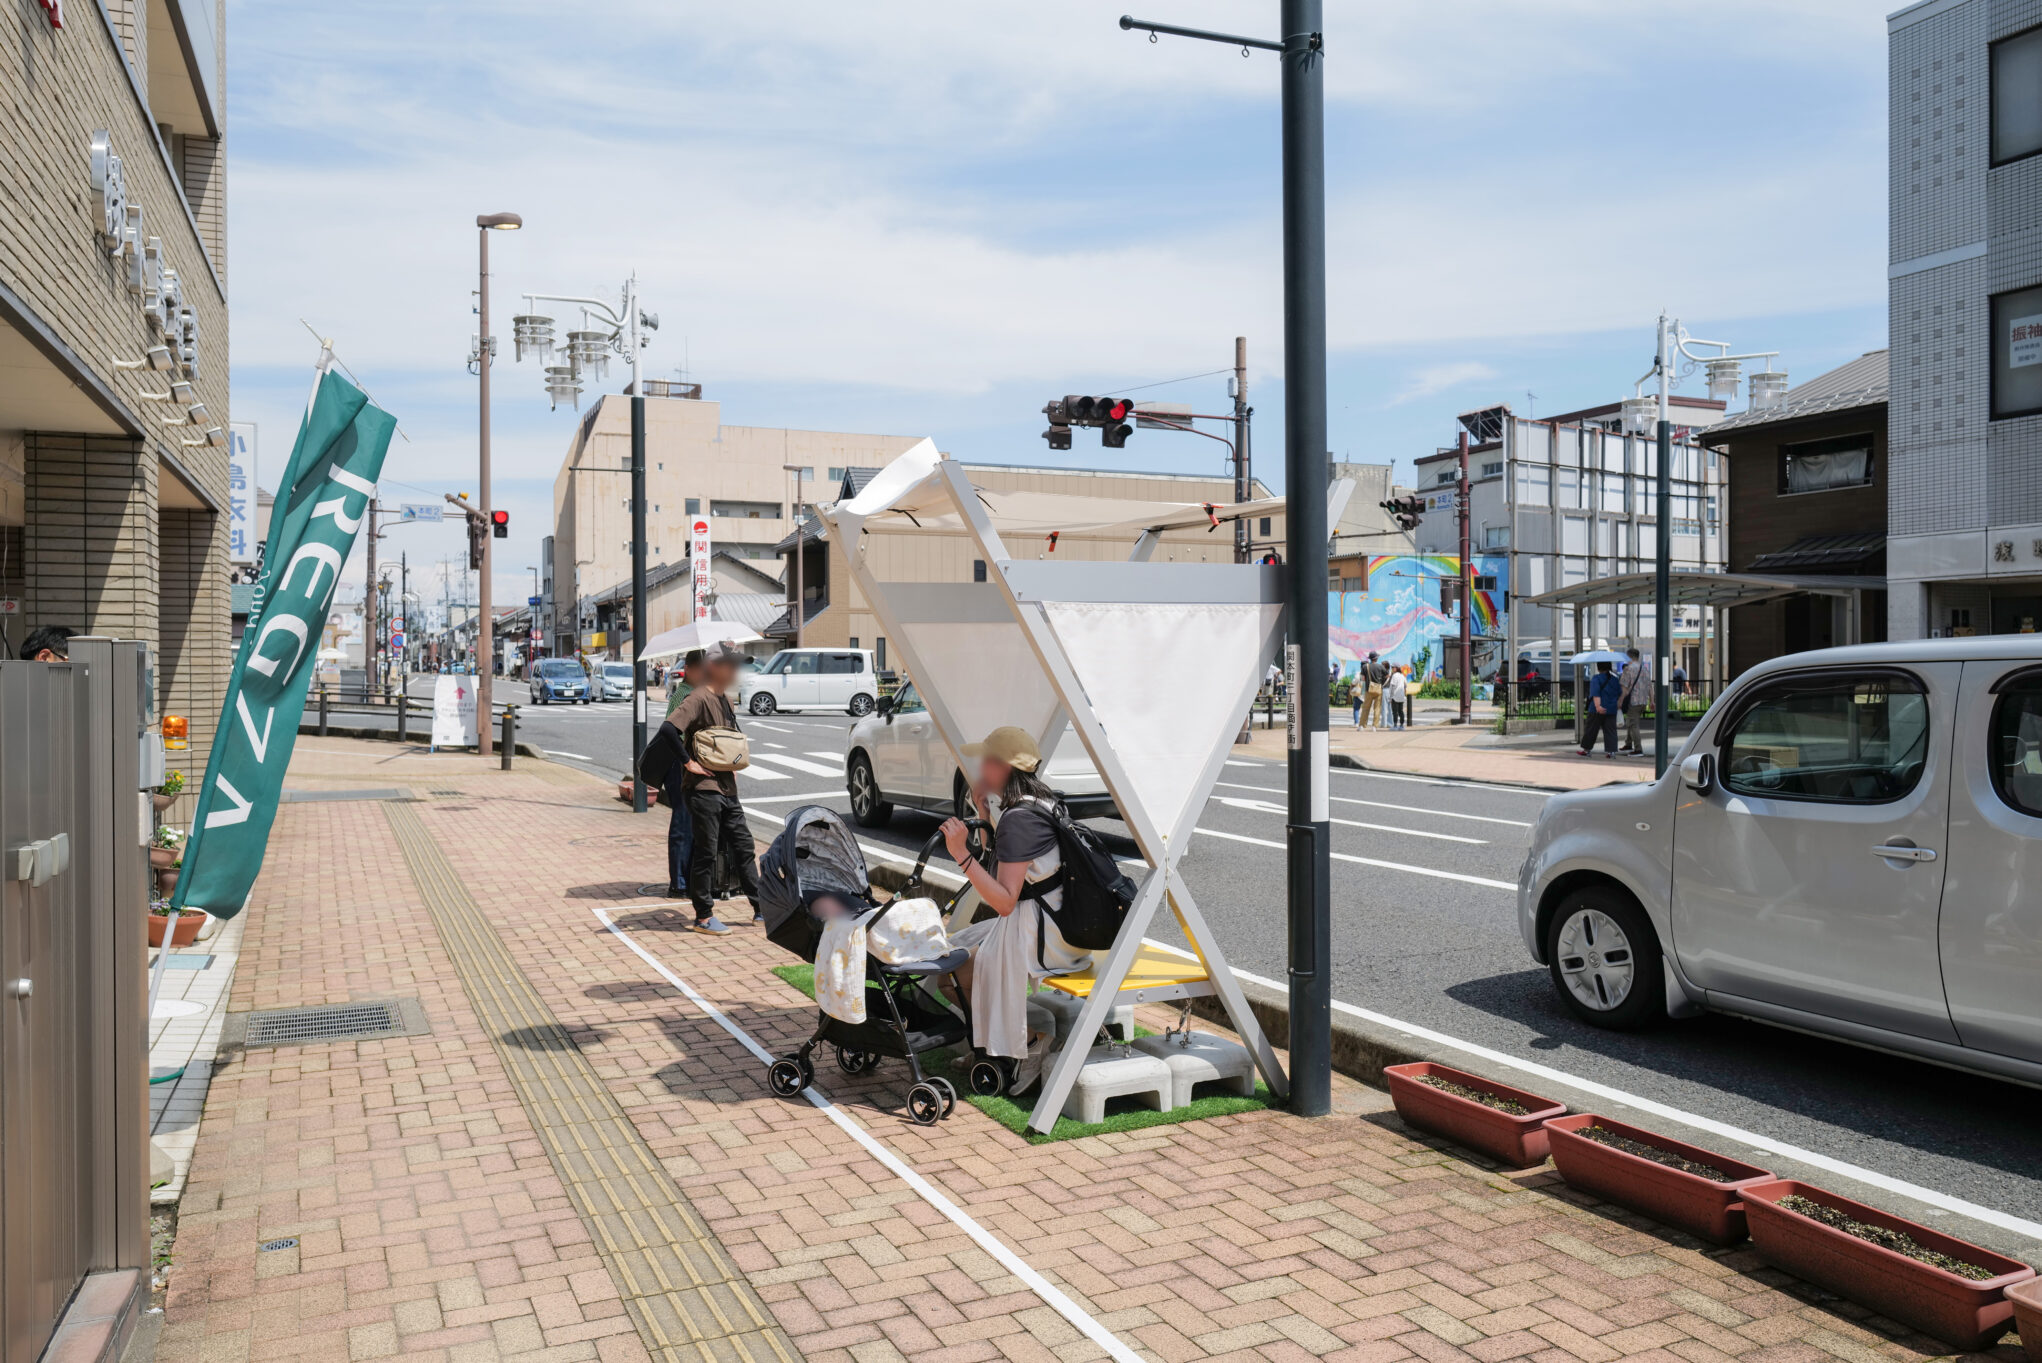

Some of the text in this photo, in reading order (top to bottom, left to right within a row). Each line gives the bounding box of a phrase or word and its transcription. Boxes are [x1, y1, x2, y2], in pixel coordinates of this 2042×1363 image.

[204, 463, 378, 829] REGZA
[694, 540, 708, 618] 関信用金庫
